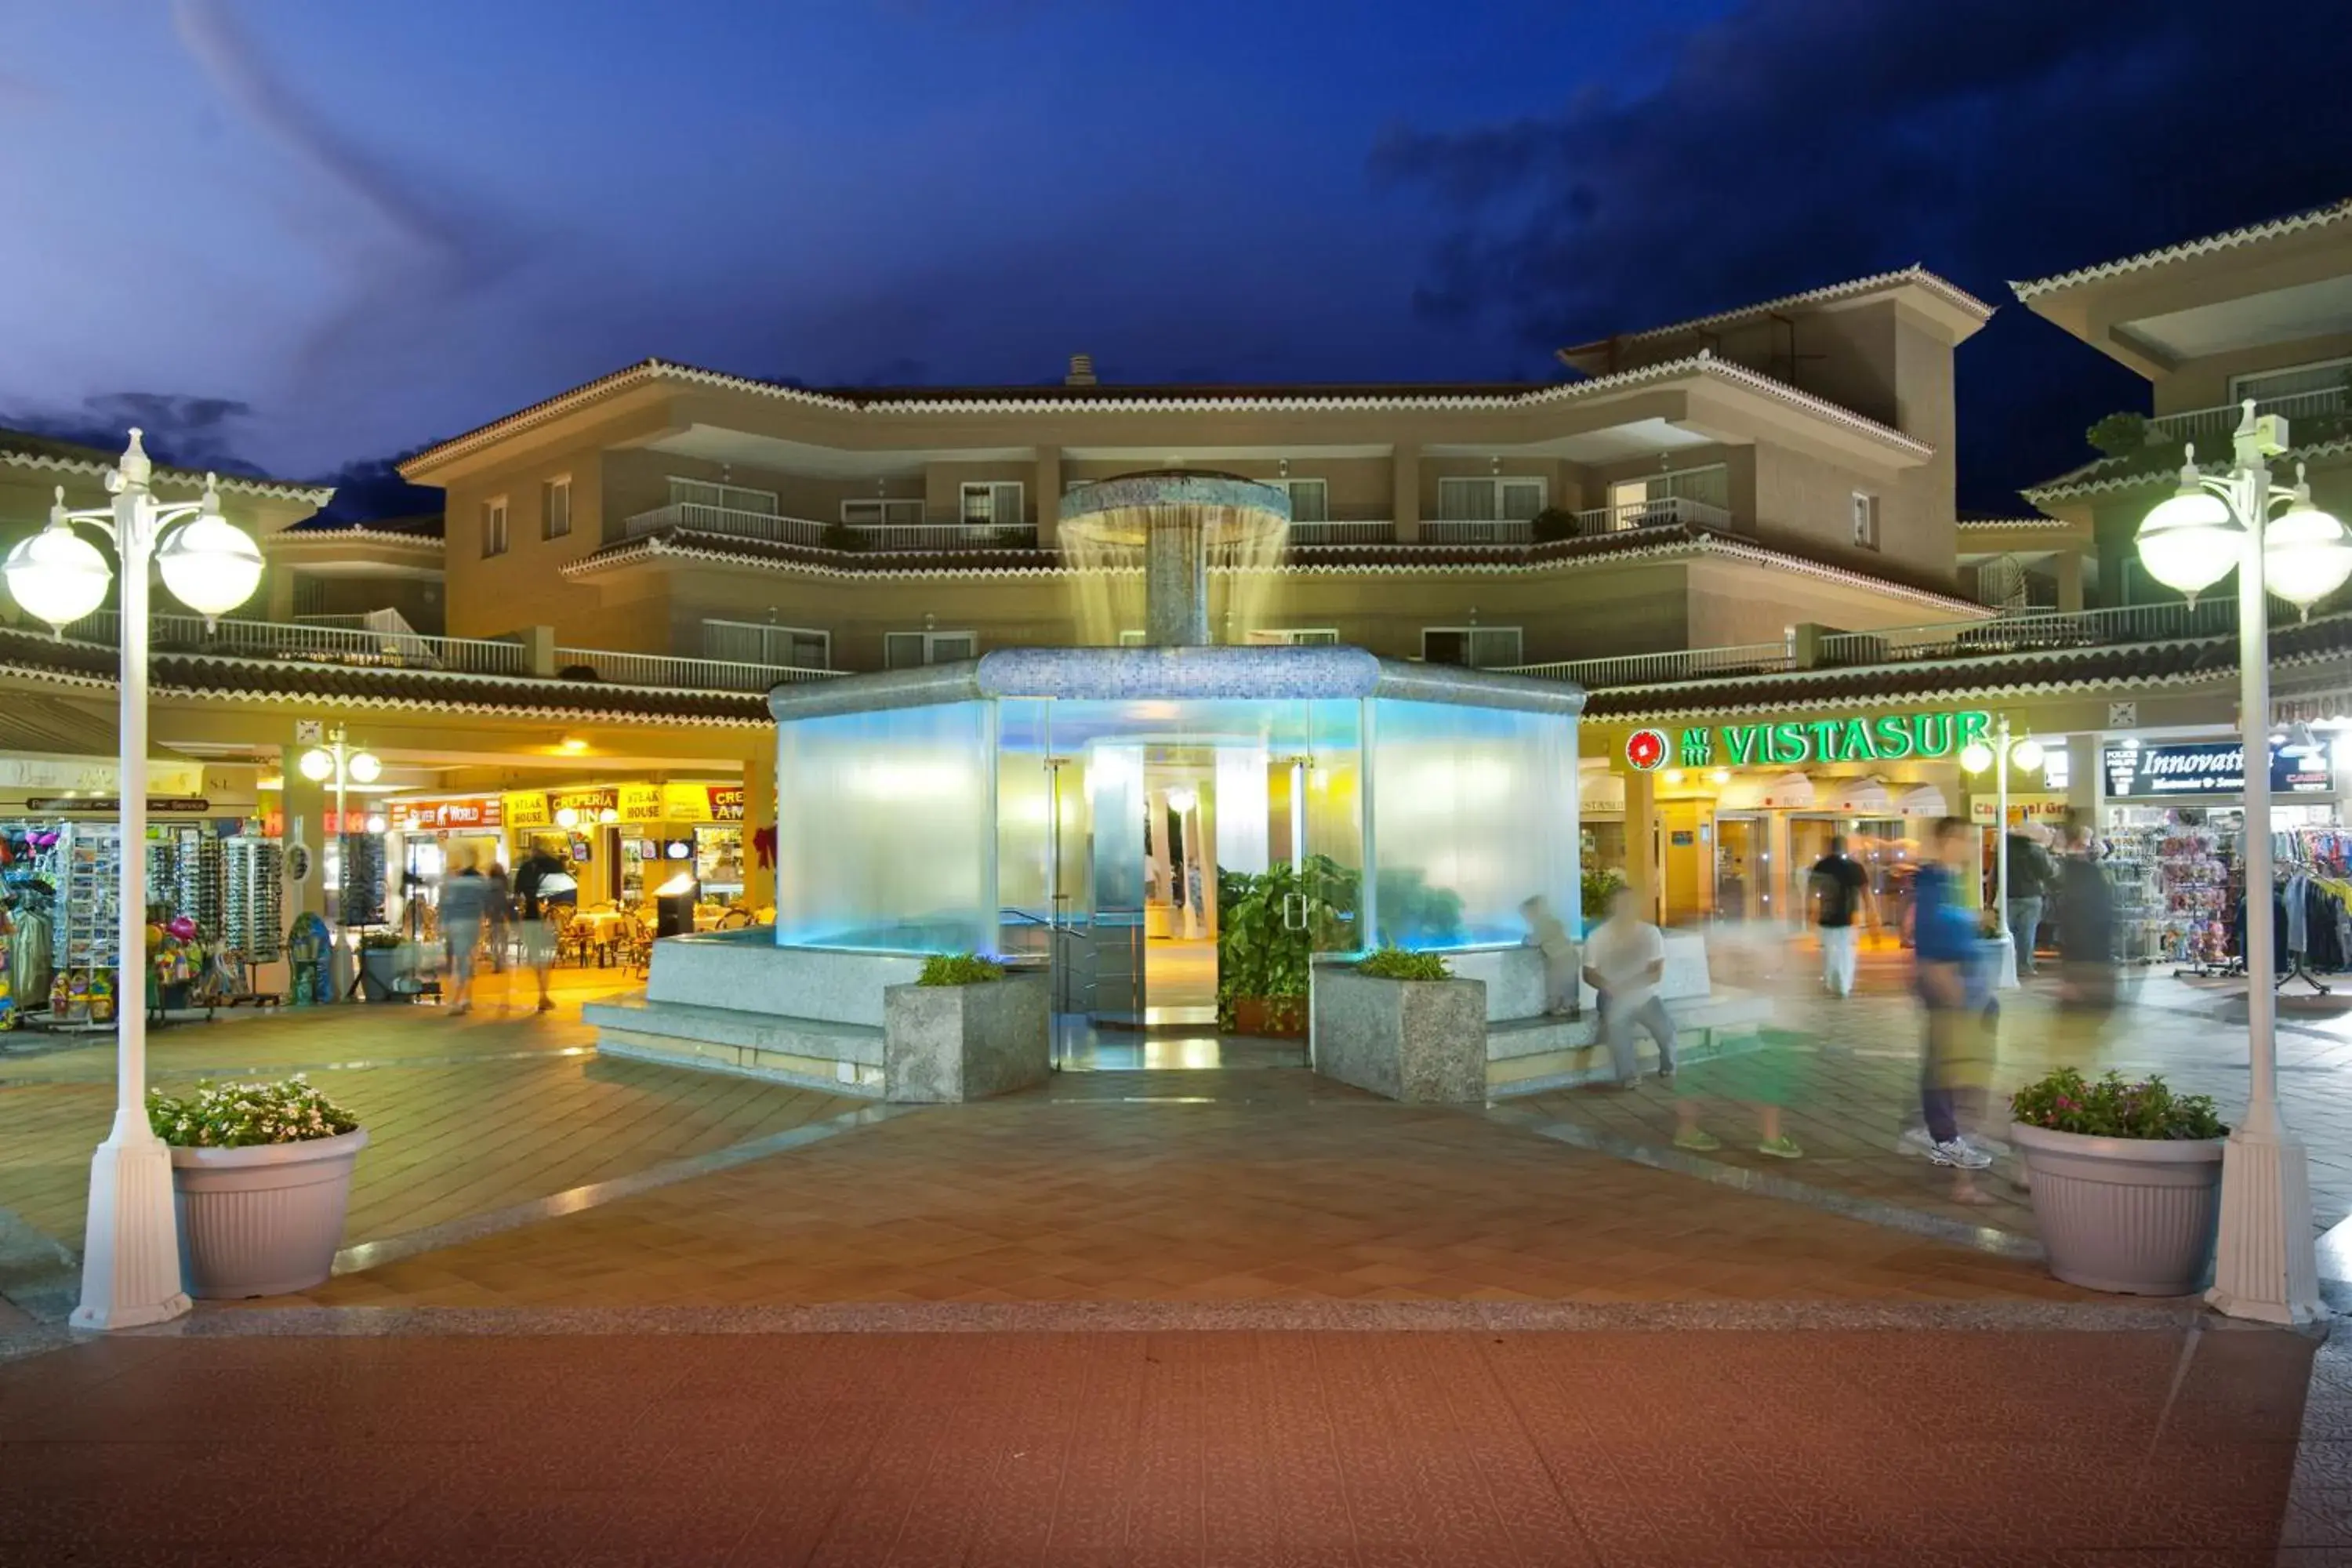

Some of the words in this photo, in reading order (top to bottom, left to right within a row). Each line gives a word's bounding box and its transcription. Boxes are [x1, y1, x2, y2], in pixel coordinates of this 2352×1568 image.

[1721, 710, 1992, 766] VISTASUR
[2141, 745, 2274, 775] Innovati
[628, 790, 659, 804] STEAK
[449, 805, 478, 821] WORLD
[514, 811, 542, 823] HOUSE
[627, 805, 659, 818] HOUSE
